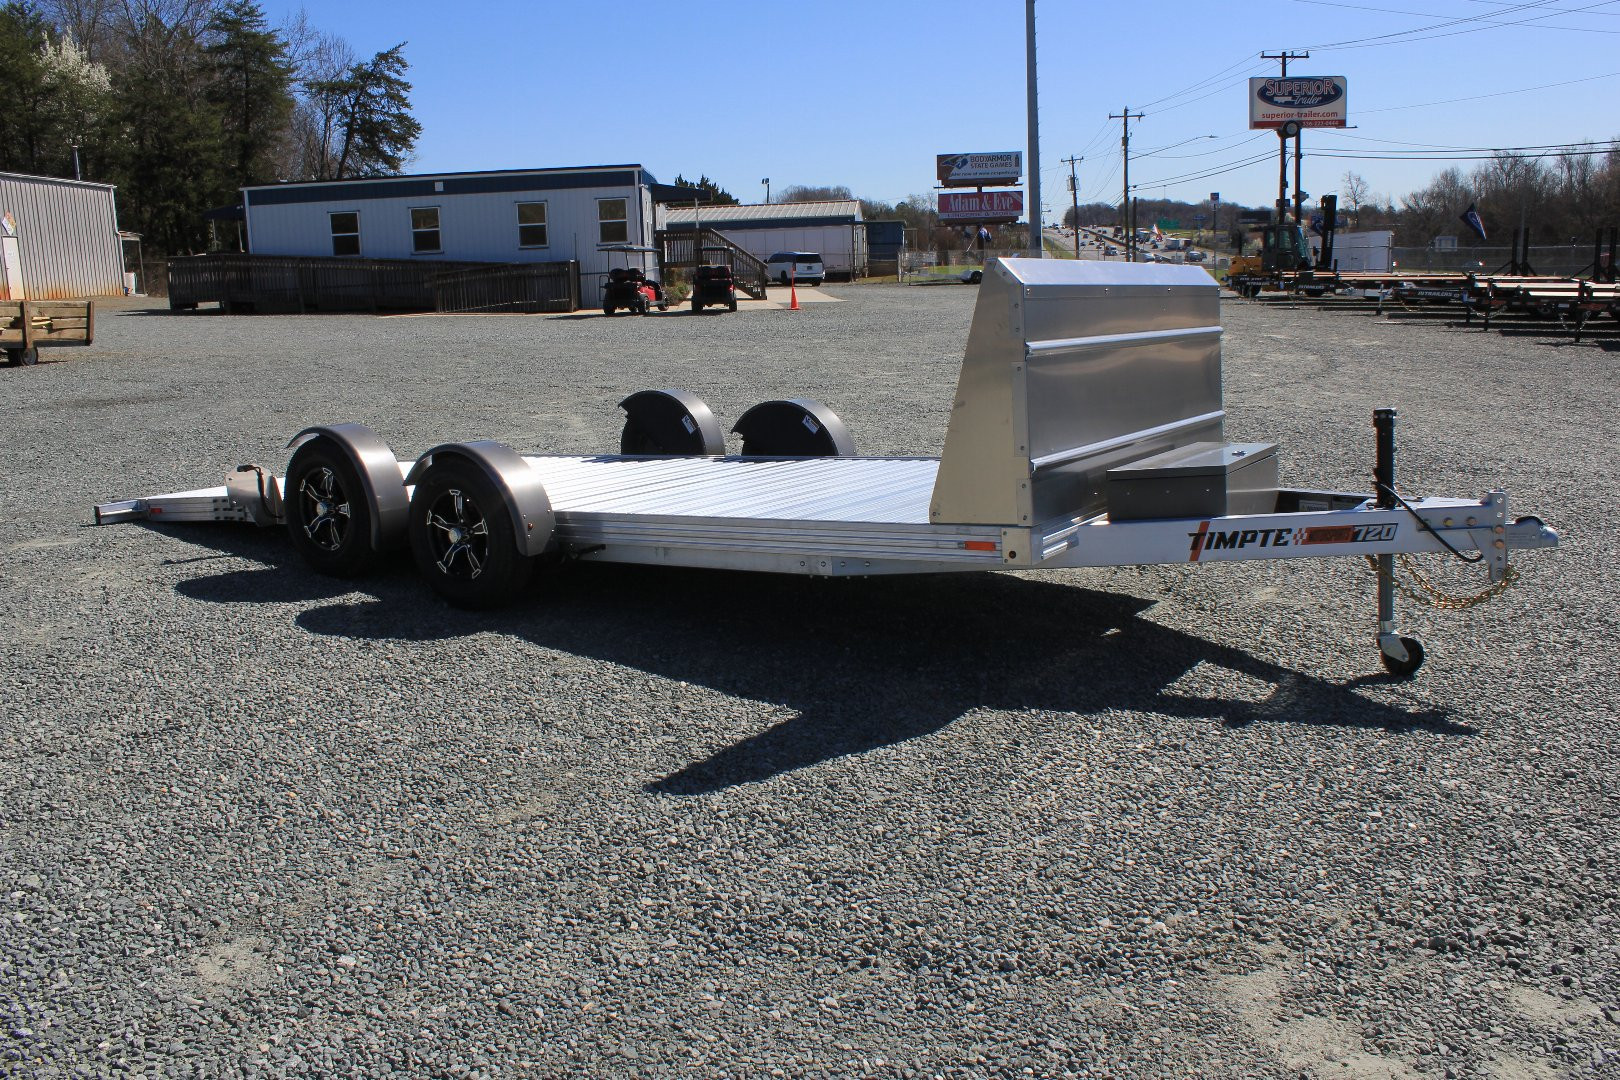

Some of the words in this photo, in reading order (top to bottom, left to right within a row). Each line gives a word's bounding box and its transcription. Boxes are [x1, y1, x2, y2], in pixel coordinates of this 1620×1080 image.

[1265, 78, 1335, 96] SUPERIOR
[1262, 111, 1338, 120] superior-trailer.com
[970, 154, 1012, 162] BODYARMOR
[948, 194, 980, 212] Adam
[982, 193, 991, 211] &
[993, 193, 1013, 210] Eve
[1187, 523, 1293, 557] TIMPTE
[1353, 525, 1396, 541] 720
